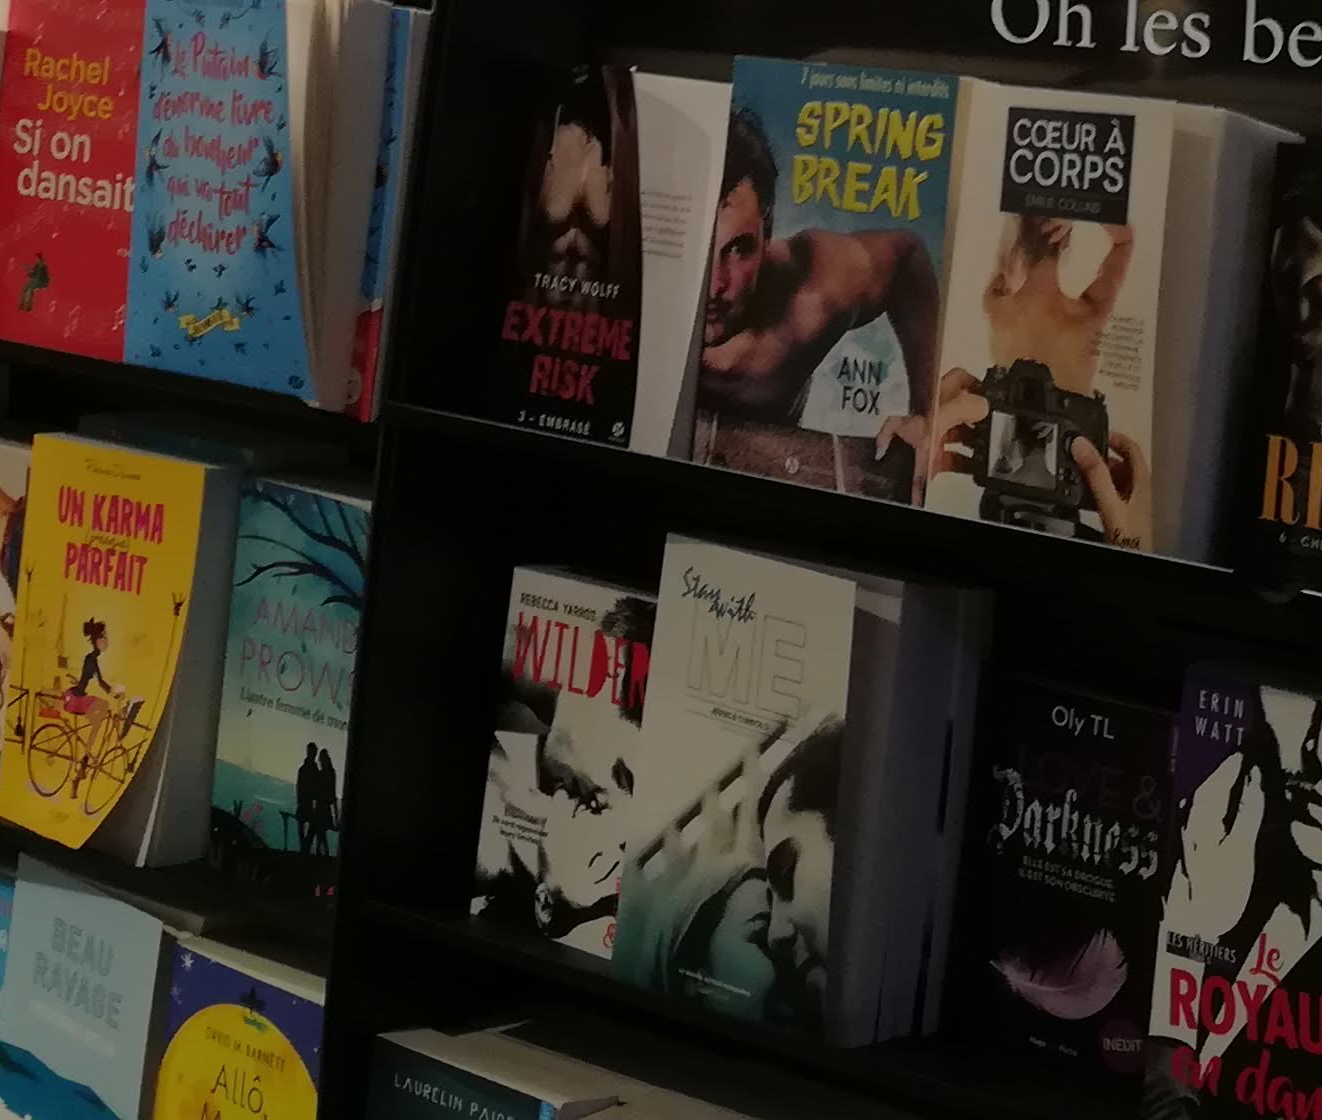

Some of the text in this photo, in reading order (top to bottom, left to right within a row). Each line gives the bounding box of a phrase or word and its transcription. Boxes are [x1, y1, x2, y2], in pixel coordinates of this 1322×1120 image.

[24, 48, 111, 84] Rachel
[37, 89, 114, 121] Joyce
[13, 118, 91, 163] Si on
[795, 101, 945, 162] SPRING
[1012, 117, 1126, 156] CŒUR À
[17, 161, 135, 213] dansait
[791, 154, 929, 222] BREAK
[1009, 149, 1125, 193] CORPS
[533, 272, 620, 299] TRACY WOLFF
[501, 300, 634, 361] EXTREME
[529, 353, 601, 405] RISK
[837, 355, 884, 382] ANN
[841, 385, 881, 416] FOX
[57, 485, 166, 545] UN KARMA
[64, 541, 149, 596] PARFAIT
[520, 592, 559, 612] REBECCA
[682, 566, 757, 622] Stay with
[241, 637, 345, 705] PROW
[686, 598, 807, 720] ME
[1051, 705, 1115, 740] Oly TL
[1198, 689, 1245, 720] ERIN
[1194, 716, 1245, 748] WATT
[987, 764, 1159, 881] Darkness
[51, 916, 117, 978] BEAU
[1185, 935, 1237, 964] HÉRITIERS
[1248, 932, 1285, 981] Le
[204, 1026, 286, 1072] DAVID BARNETT
[394, 1073, 463, 1112] LAURELIN
